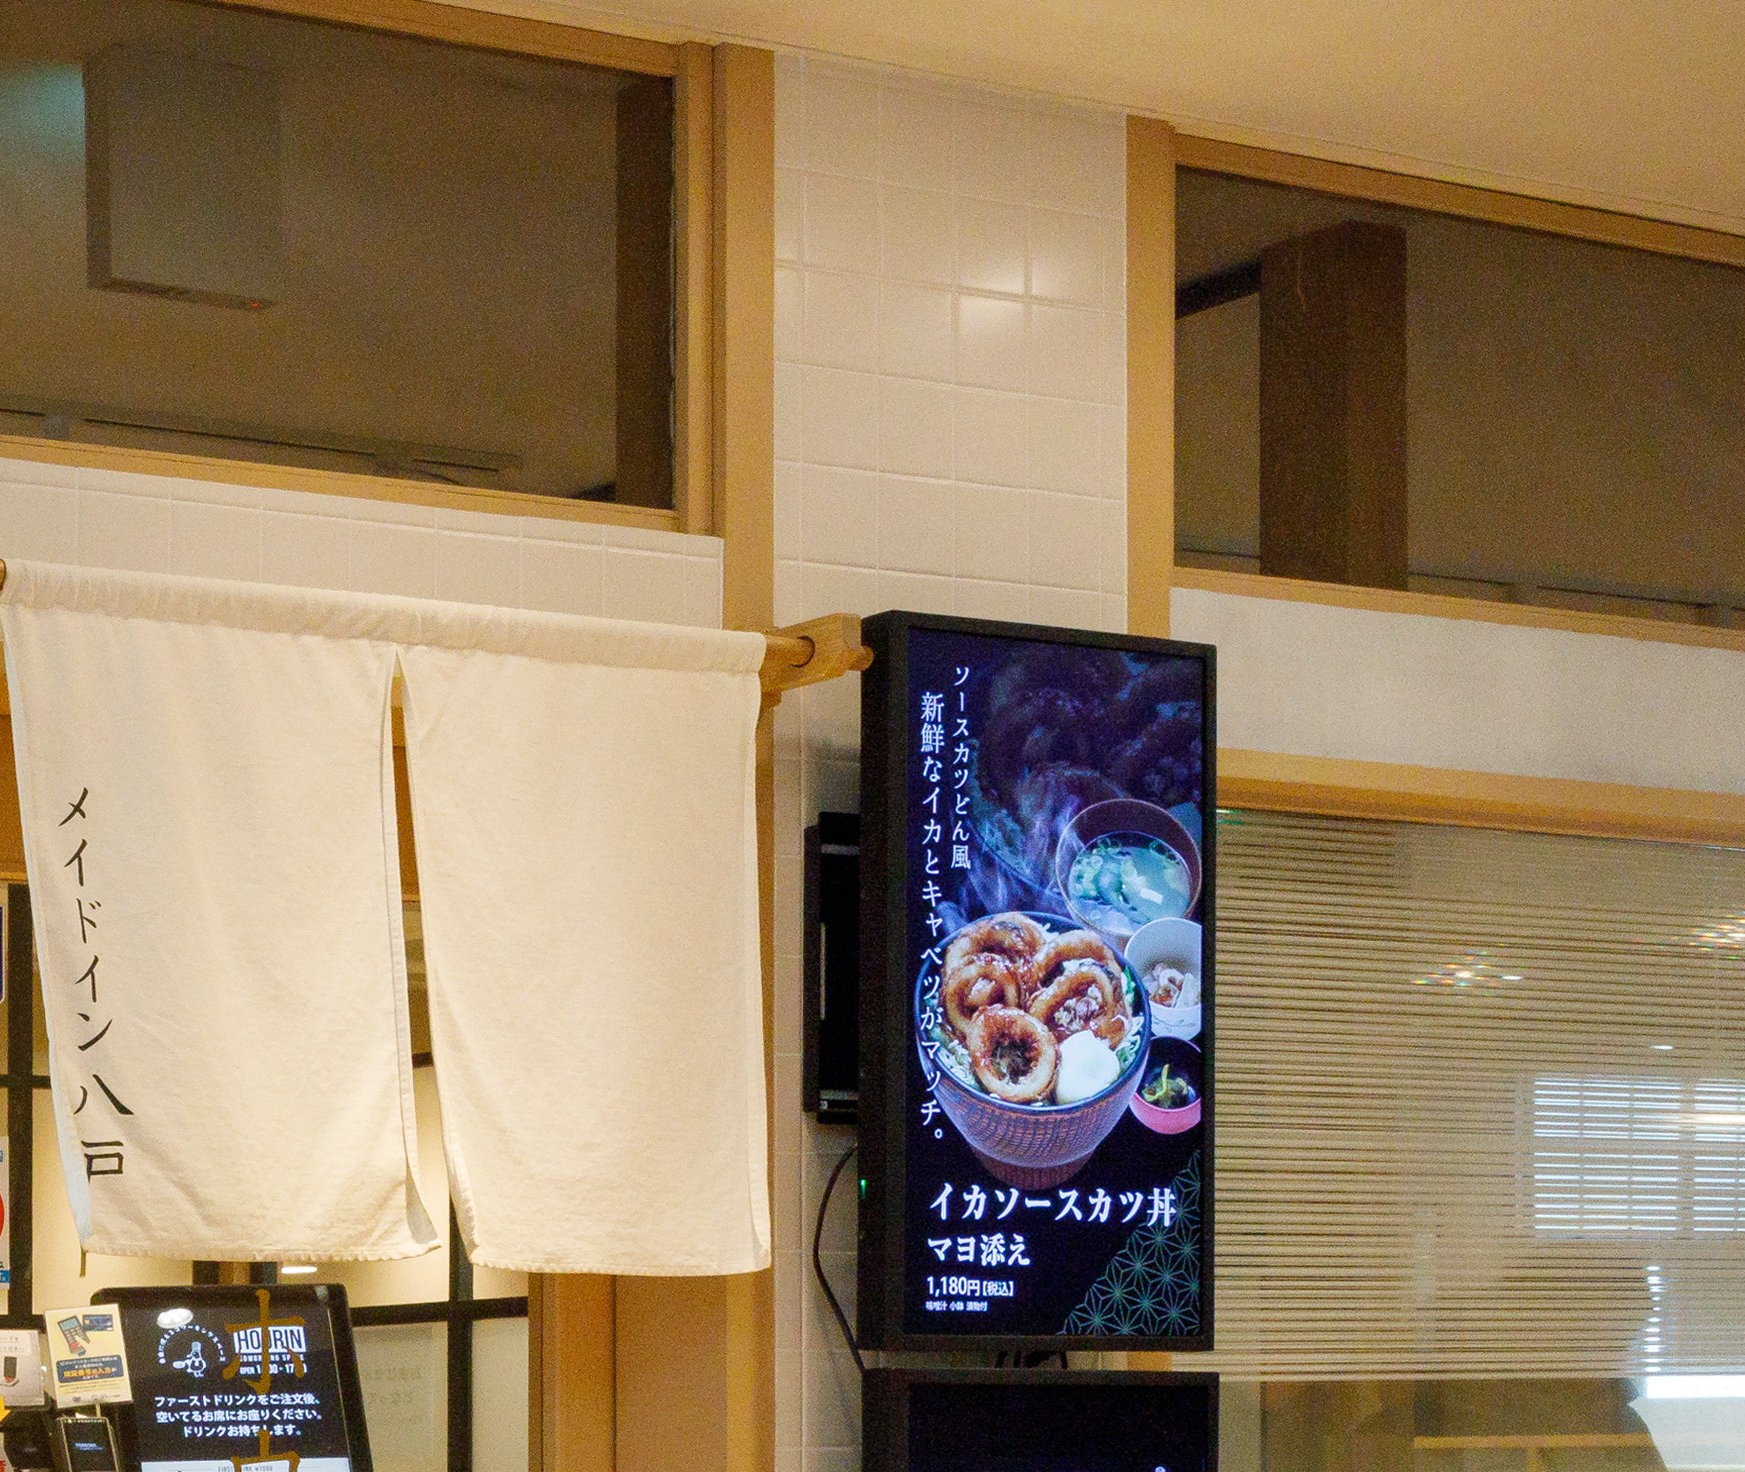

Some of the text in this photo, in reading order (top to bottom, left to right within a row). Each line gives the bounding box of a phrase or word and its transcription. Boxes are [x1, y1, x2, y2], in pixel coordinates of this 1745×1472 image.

[951, 666, 972, 870] ソースカツどん風
[919, 692, 944, 1140] 新鮮なイカとキャベツがマッチ。
[58, 787, 134, 1183] メイドイン八戸
[927, 1234, 1031, 1267] マヨ添え
[929, 1182, 1177, 1228] イカソースカツ丼
[237, 1328, 304, 1351] HORIN
